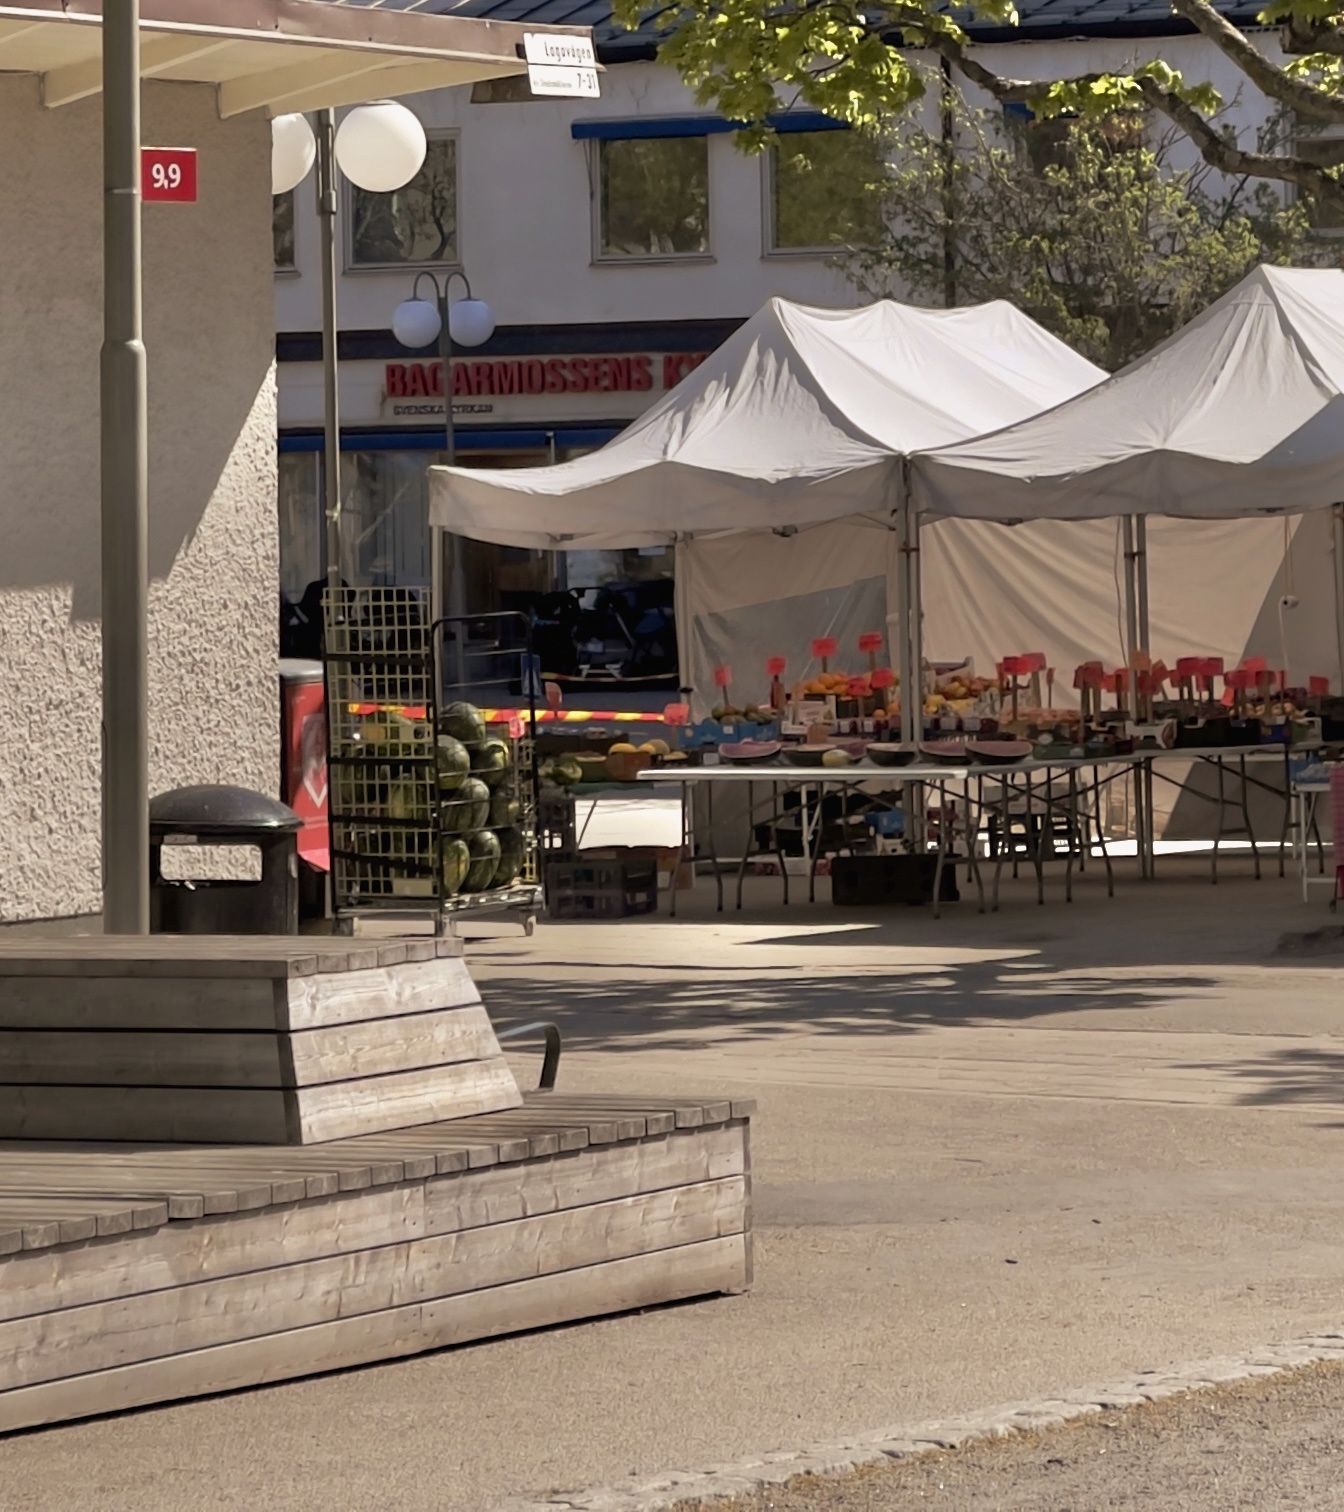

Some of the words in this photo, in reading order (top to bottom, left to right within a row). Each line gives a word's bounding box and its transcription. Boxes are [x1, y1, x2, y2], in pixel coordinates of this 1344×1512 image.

[577, 72, 596, 90] 7-31
[152, 163, 181, 190] 9,9
[386, 355, 653, 398] BAGARMOSSENS
